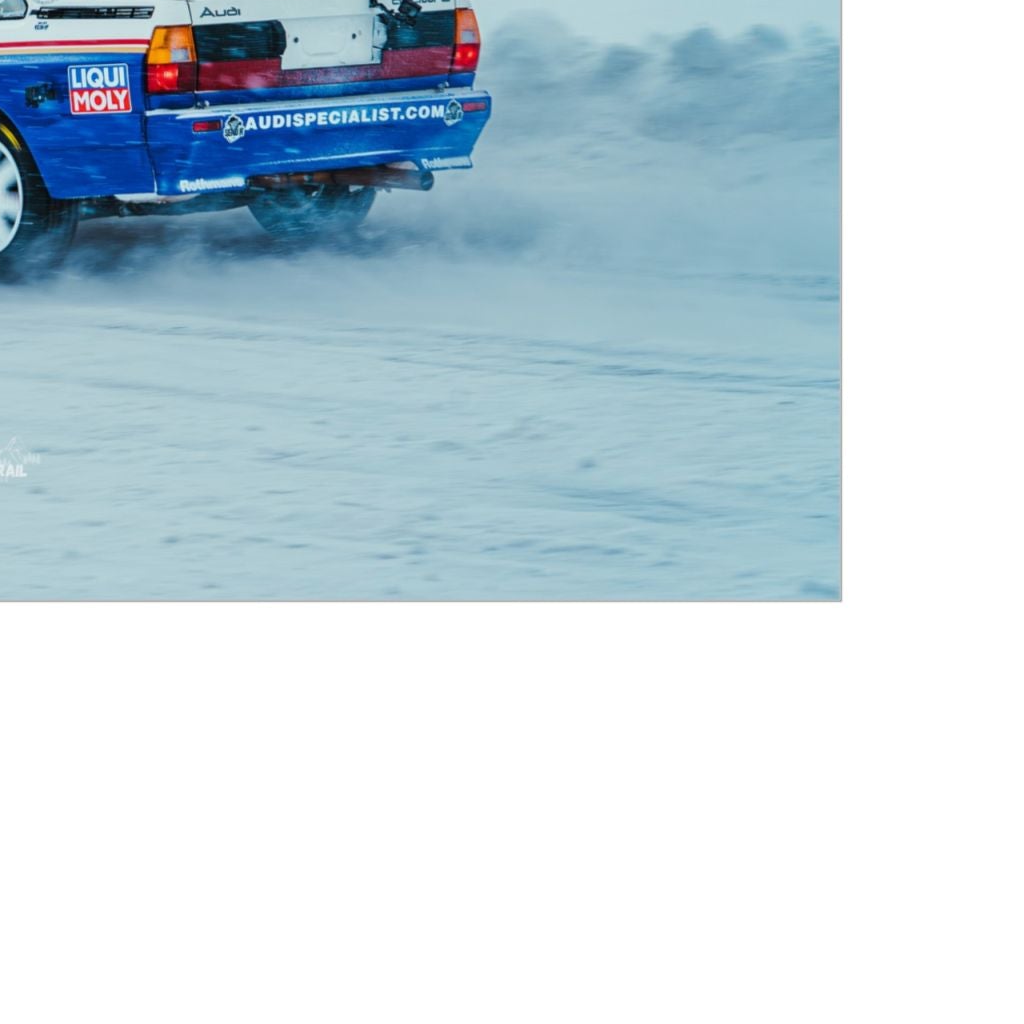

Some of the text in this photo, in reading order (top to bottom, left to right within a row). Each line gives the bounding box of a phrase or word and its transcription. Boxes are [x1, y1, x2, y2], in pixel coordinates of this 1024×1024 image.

[200, 7, 241, 18] Audi
[71, 66, 126, 89] LIQUI
[72, 89, 128, 112] MOLY
[245, 104, 445, 131] AUDISPECIALIST.COM
